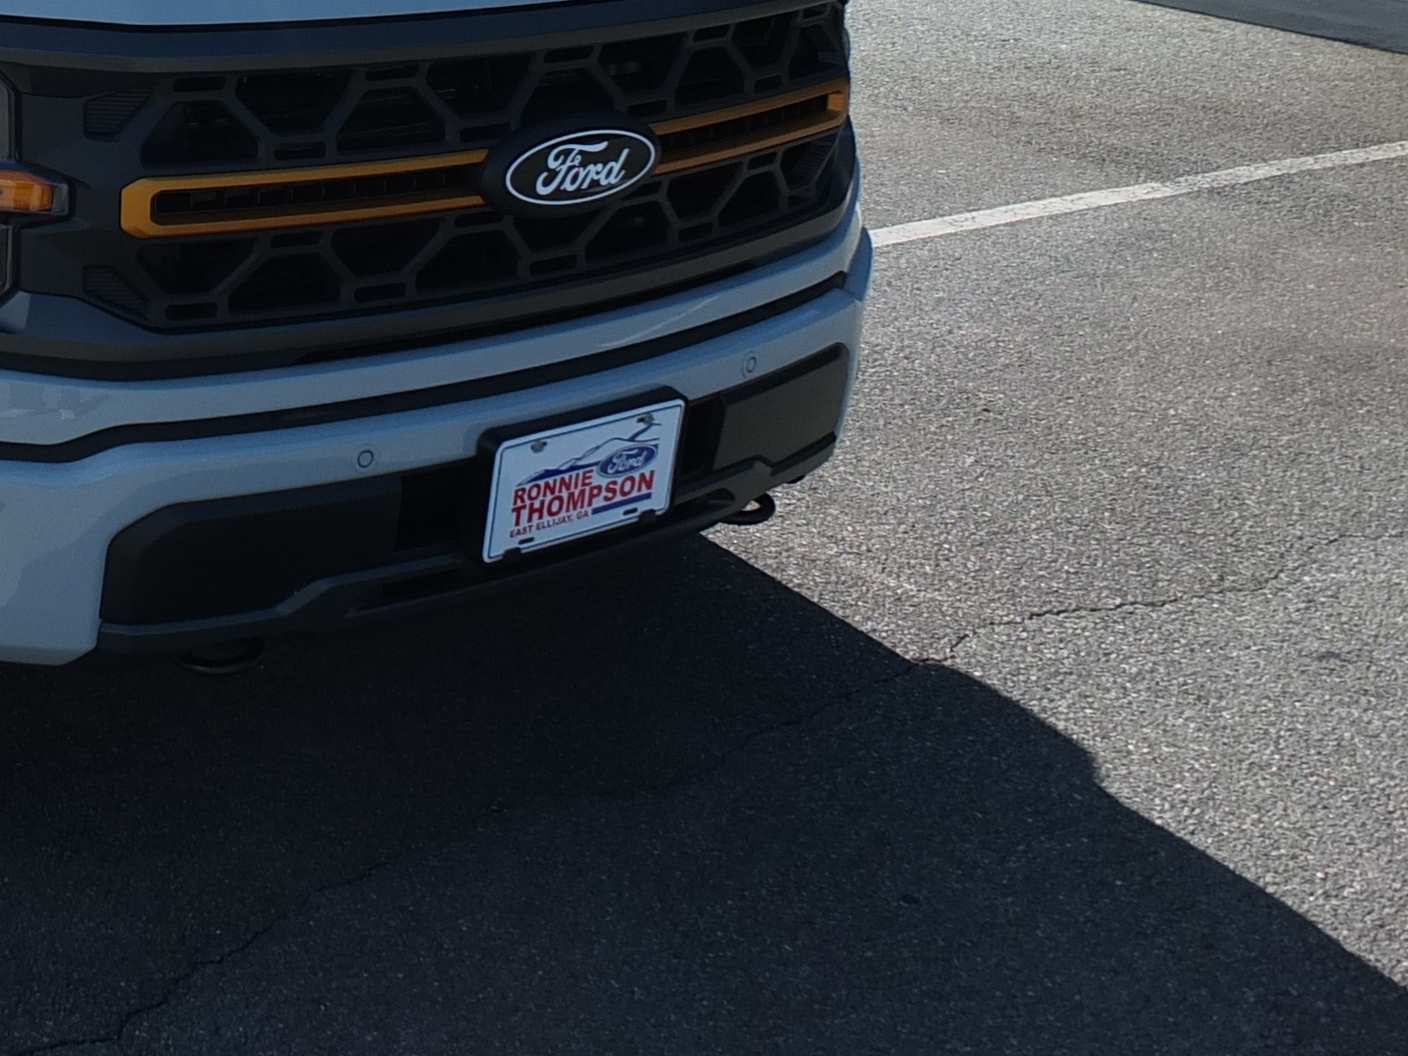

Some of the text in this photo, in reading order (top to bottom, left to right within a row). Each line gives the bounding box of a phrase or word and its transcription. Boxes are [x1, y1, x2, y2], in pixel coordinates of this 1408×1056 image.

[535, 140, 630, 195] Ford
[607, 448, 647, 474] Ford
[511, 470, 655, 527] THOMPSON
[513, 469, 594, 506] RONNIE
[509, 524, 533, 538] EAST
[576, 510, 589, 520] GA
